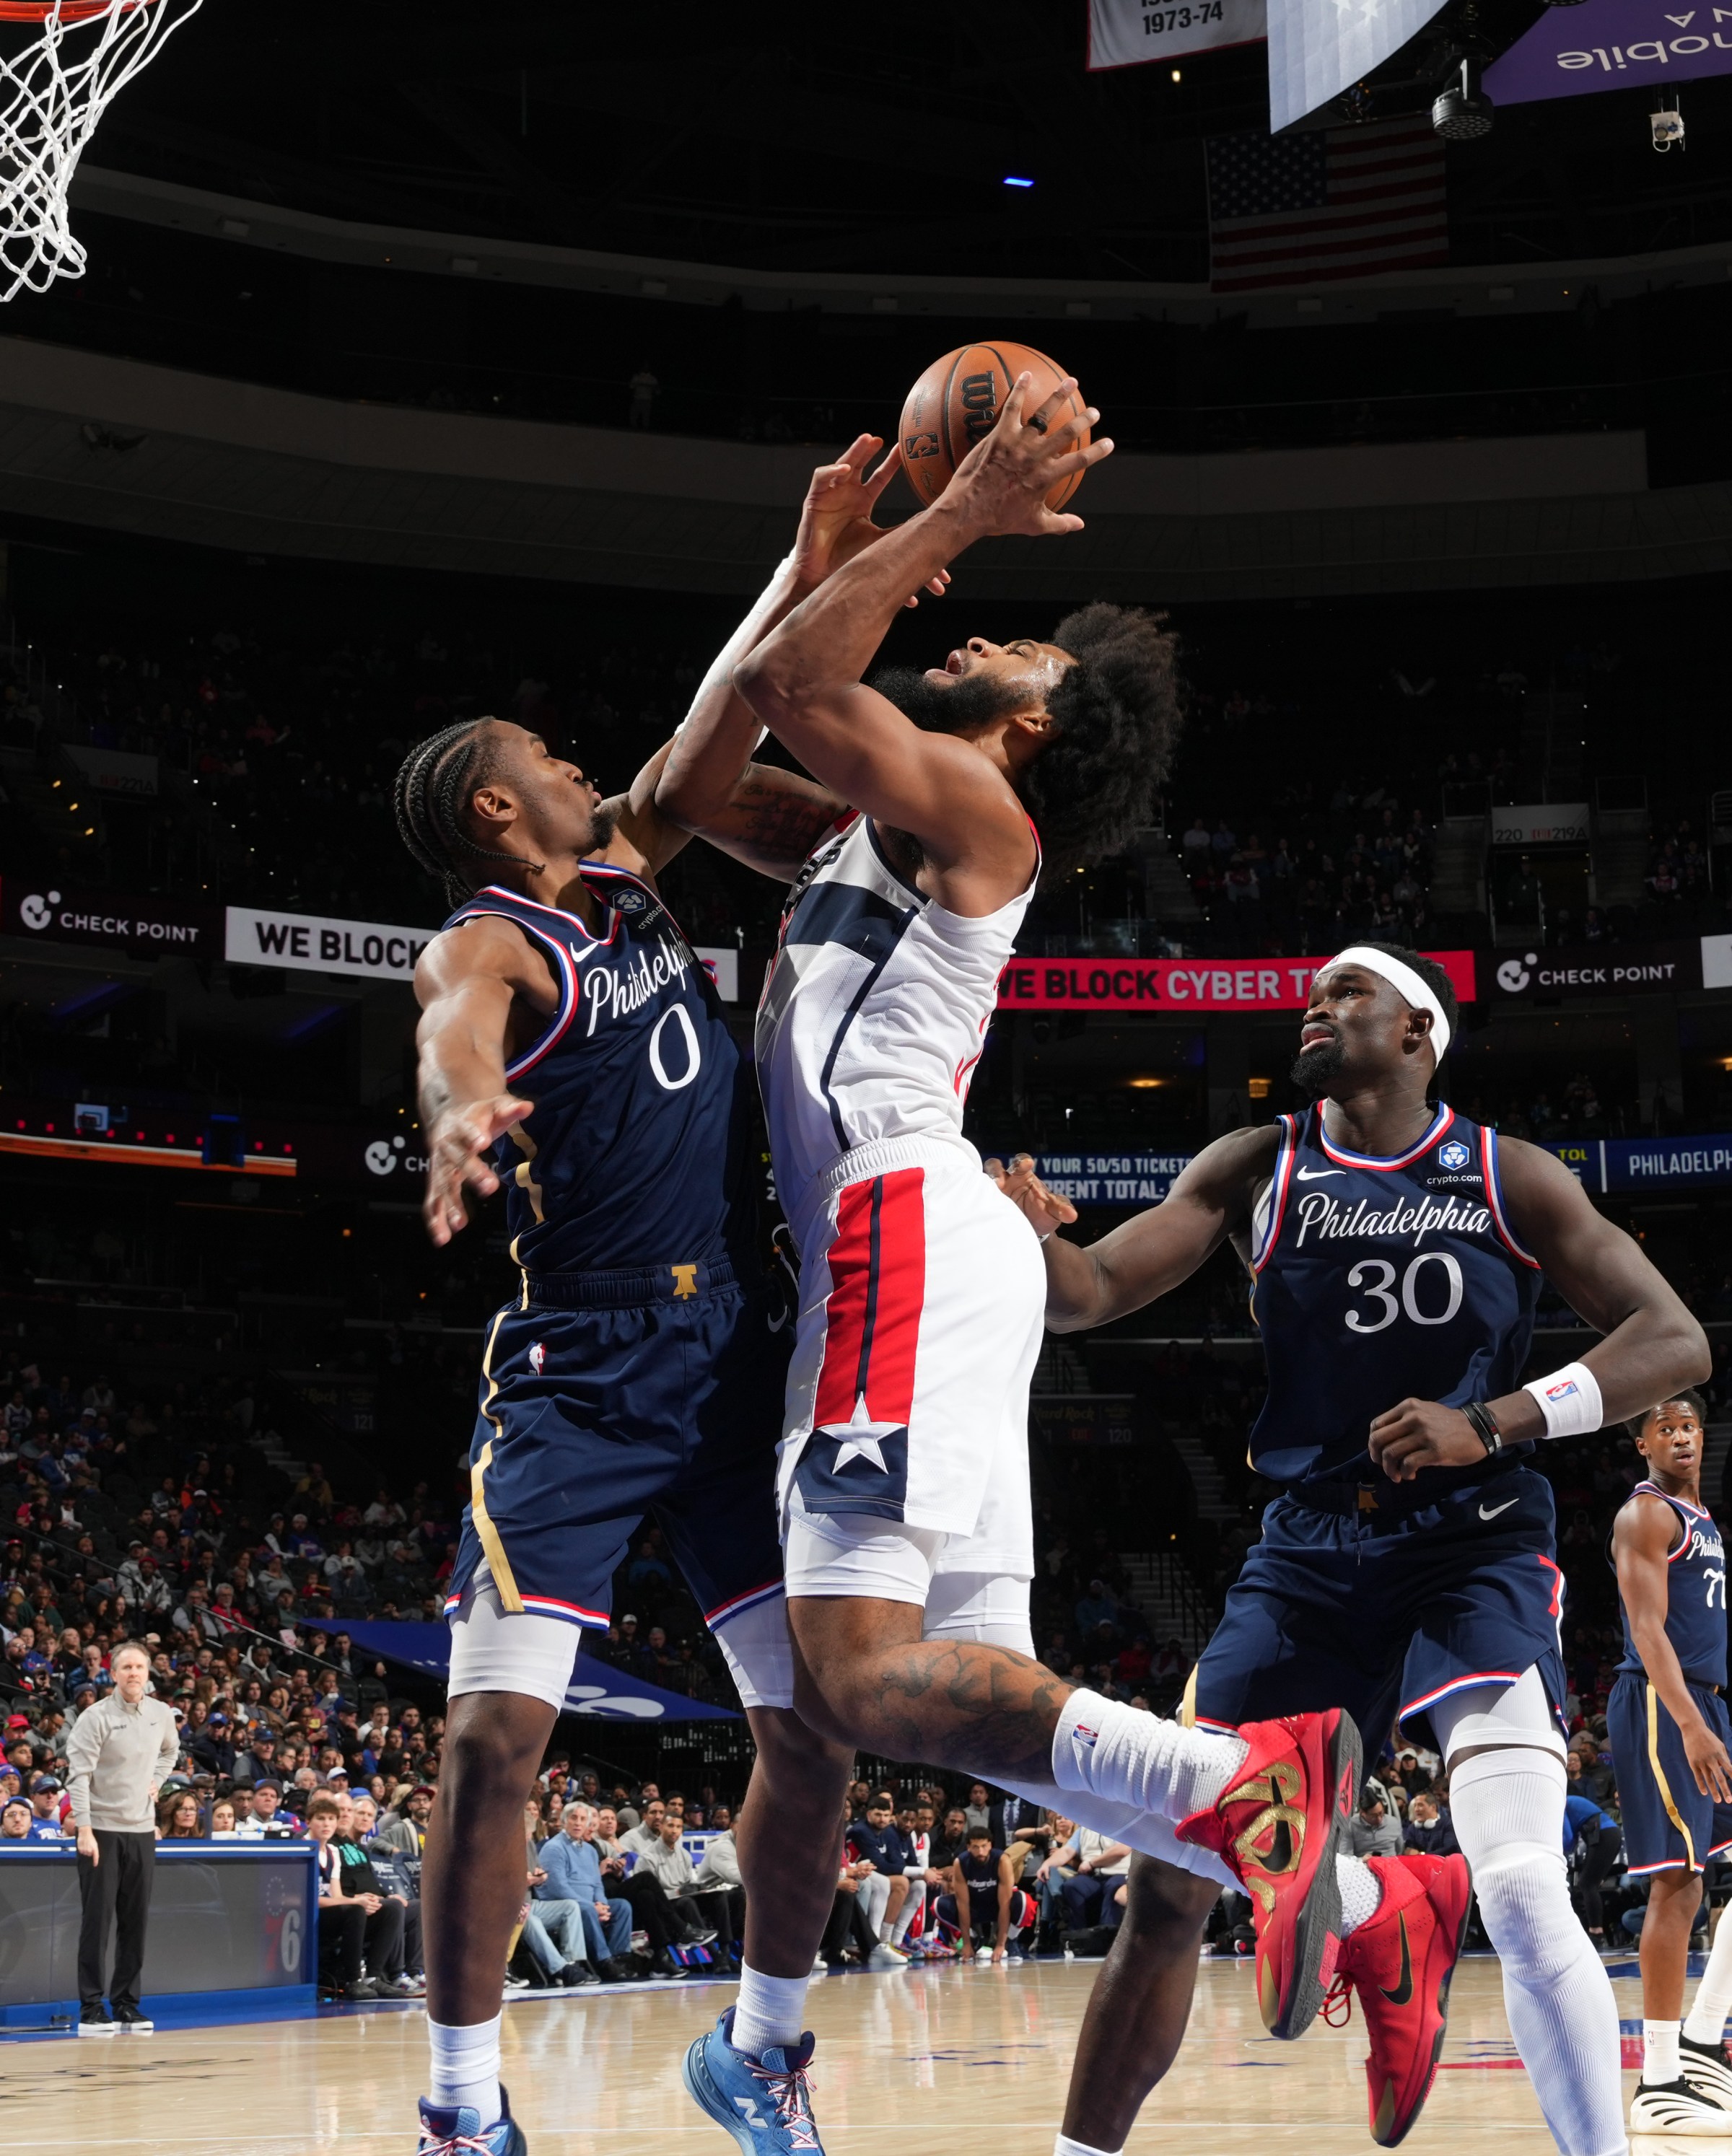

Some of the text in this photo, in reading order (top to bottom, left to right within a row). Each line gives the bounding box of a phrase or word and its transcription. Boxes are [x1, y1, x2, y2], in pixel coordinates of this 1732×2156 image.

[1143, 1, 1223, 35] 1973-74
[1495, 829, 1522, 841] 220
[1552, 826, 1587, 840] 219A
[61, 913, 198, 942] CHECK POINT
[255, 921, 310, 958] WE
[1046, 969, 1161, 999] BLOCK
[1168, 969, 1281, 999] CYBER
[1539, 964, 1675, 985] CHECK POINT
[650, 1003, 701, 1090] 0
[1042, 1157, 1081, 1173] YOUR
[1087, 1157, 1131, 1173] 50/50
[1557, 1149, 1588, 1161] TOL
[1104, 1180, 1164, 1199] TOTAL:
[1427, 1175, 1482, 1185] crypto.com
[1296, 1193, 1492, 1248] Philadelphia
[1344, 1252, 1464, 1333] 30
[354, 1414, 375, 1430] 121
[1108, 1428, 1133, 1443] 120
[265, 1909, 301, 1972] 76
